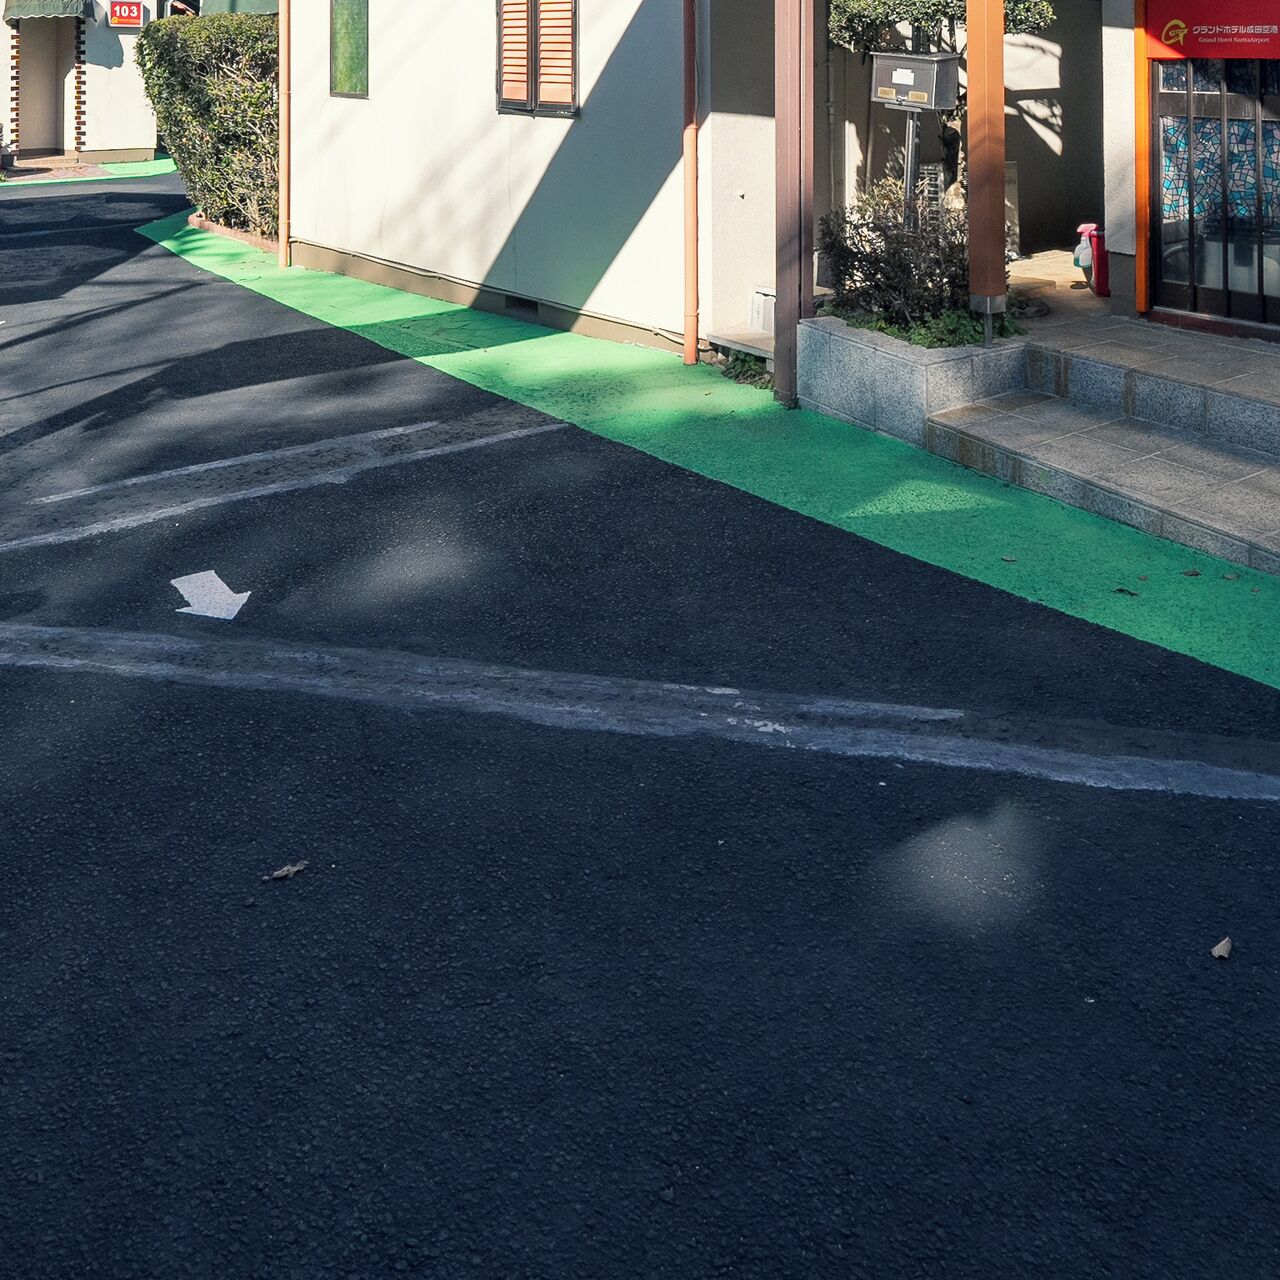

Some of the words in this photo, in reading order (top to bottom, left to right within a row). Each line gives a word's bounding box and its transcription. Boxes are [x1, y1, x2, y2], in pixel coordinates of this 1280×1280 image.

[113, 5, 138, 17] 103
[1192, 25, 1278, 34] グランドホテル成田空港
